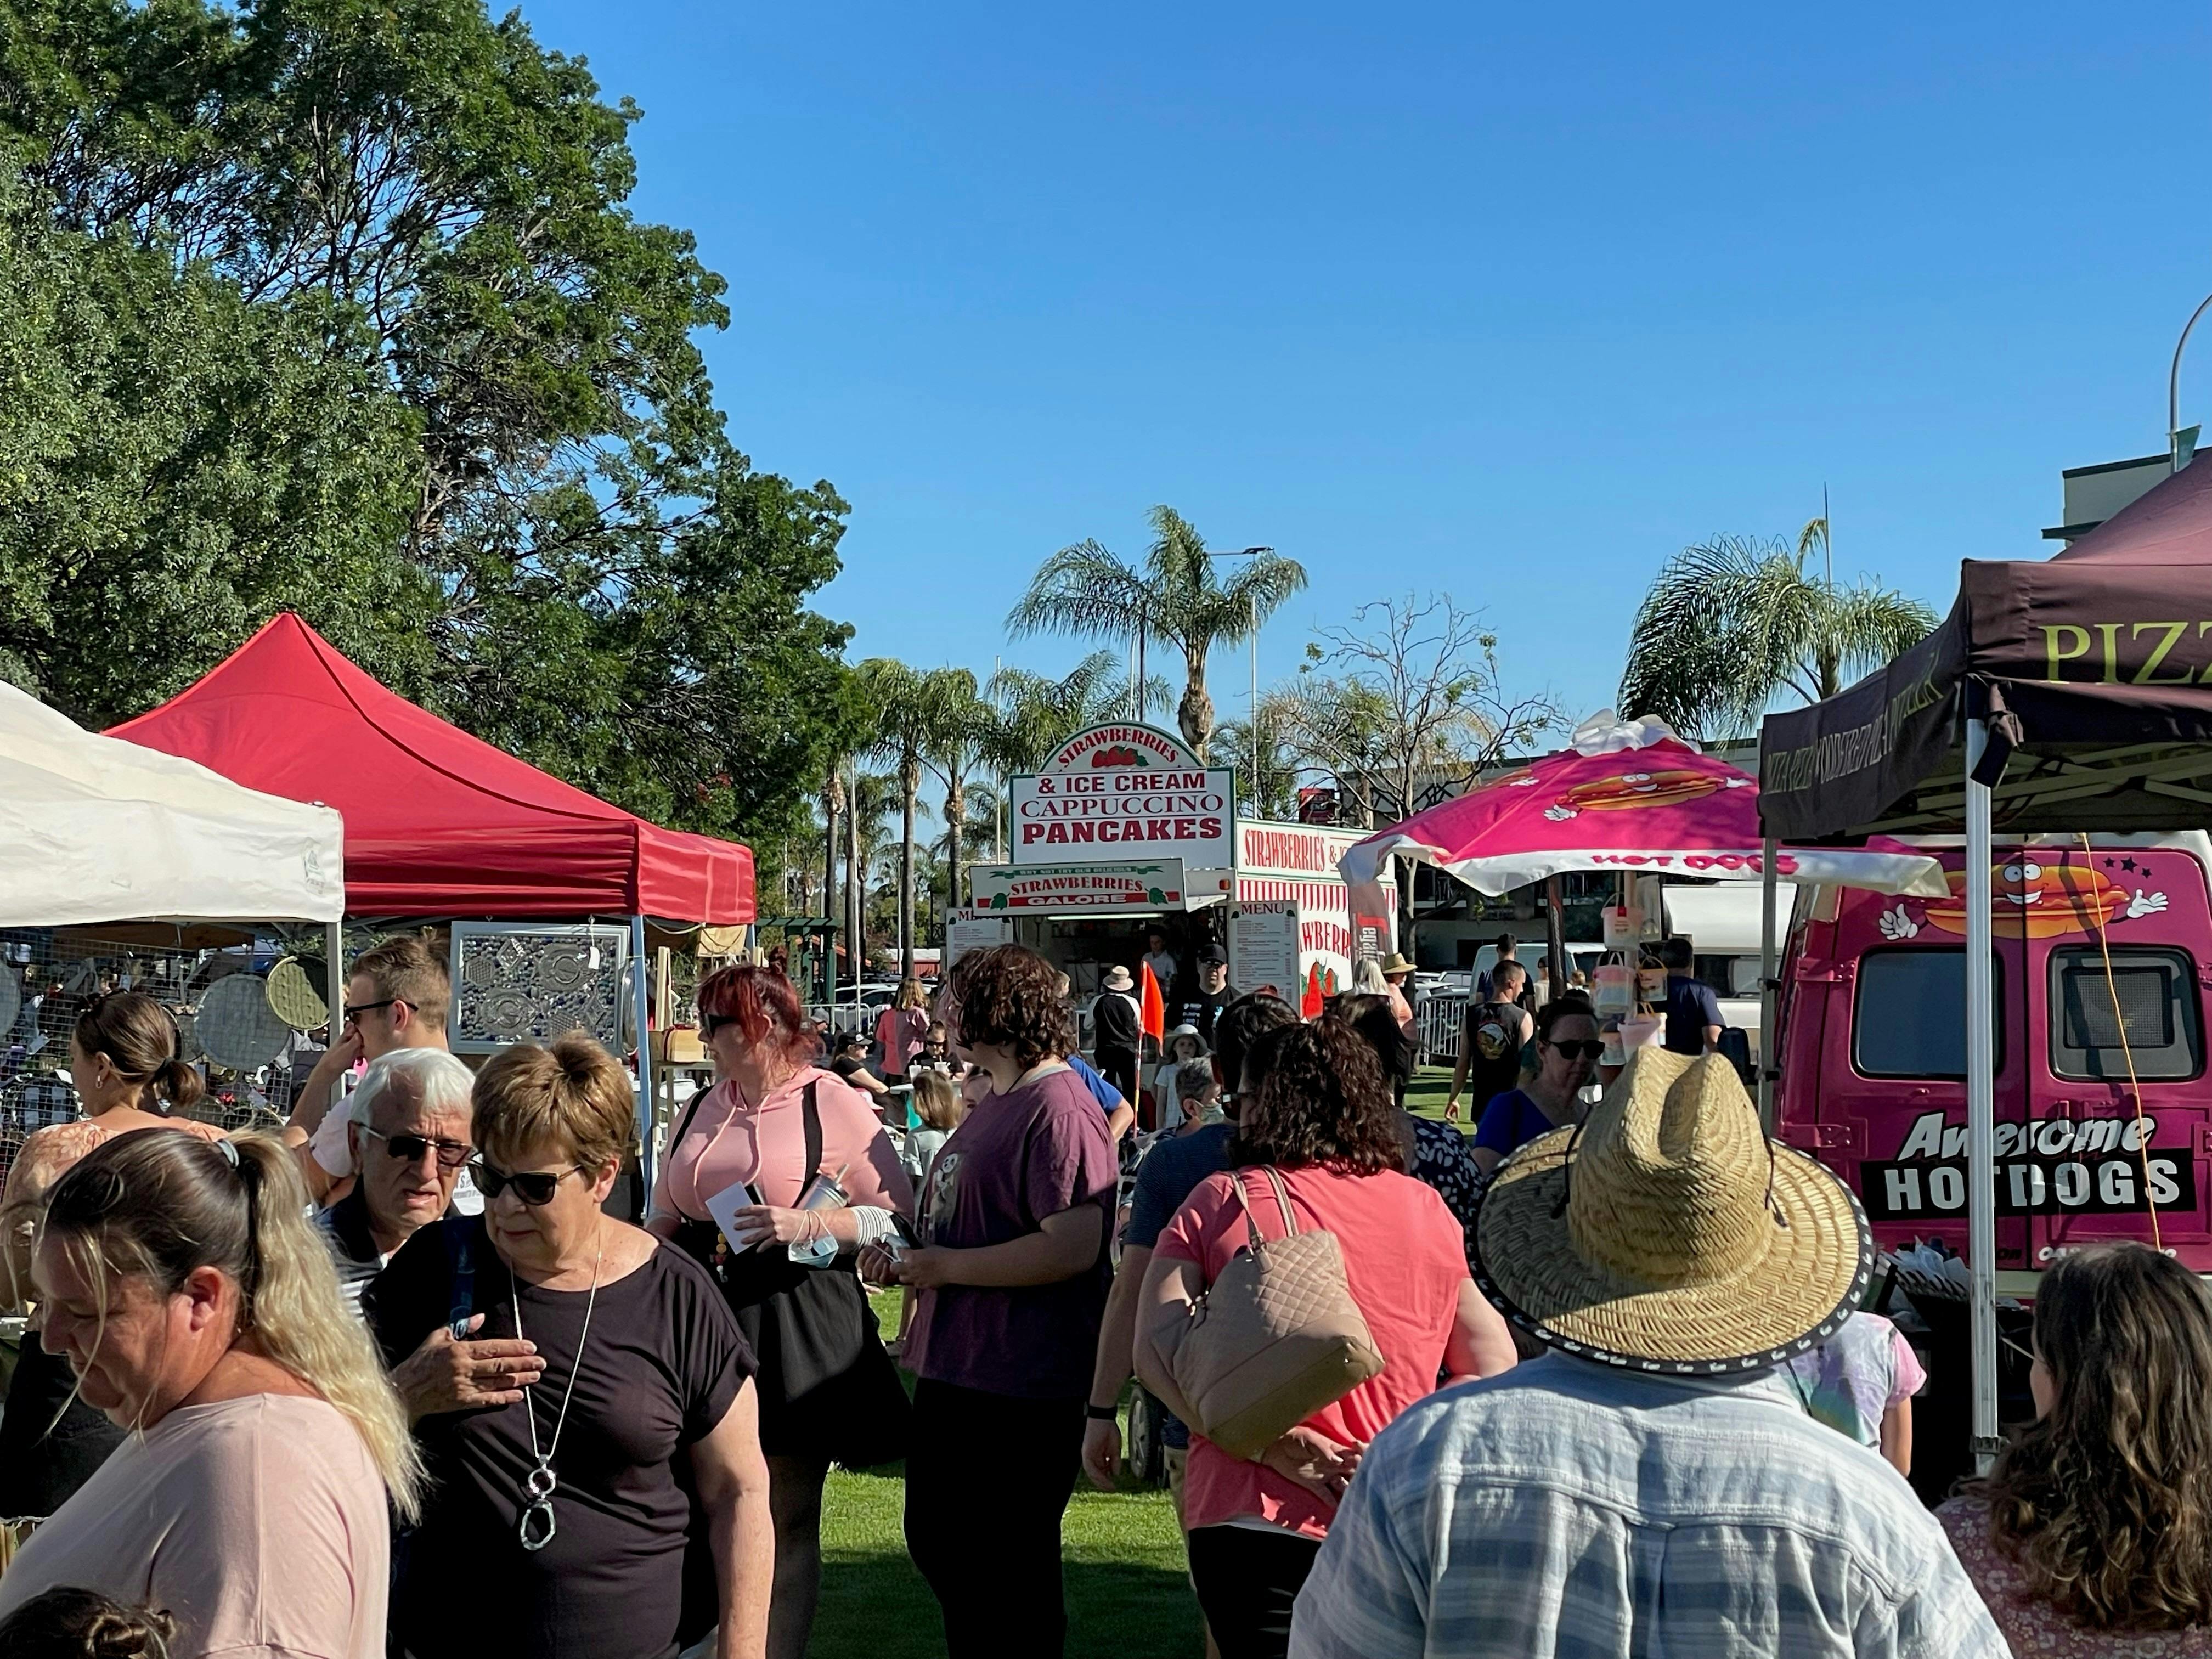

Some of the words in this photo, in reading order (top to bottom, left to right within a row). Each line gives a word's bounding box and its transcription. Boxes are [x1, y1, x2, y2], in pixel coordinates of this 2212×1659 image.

[2037, 622, 2212, 685] PIZ
[1058, 728, 1179, 767] STRAWBERRIES
[1038, 777, 1056, 794] &
[1066, 776, 1105, 793] ICE
[1114, 772, 1205, 791] CREAM
[1020, 794, 1224, 818] CAPPUCCINO
[1023, 817, 1222, 844] PANCAKES
[1245, 829, 1325, 872] STRAWBERRIES
[1329, 845, 1337, 864] &
[1591, 855, 1674, 867] HOT
[1683, 854, 1800, 875] DOGS
[1011, 877, 1143, 896] STRAWBERRIES
[1027, 894, 1127, 905] GALORE
[1241, 902, 1284, 915] MENU
[1299, 921, 1351, 960] WBERR
[1884, 1159, 2180, 1211] HODOGS
